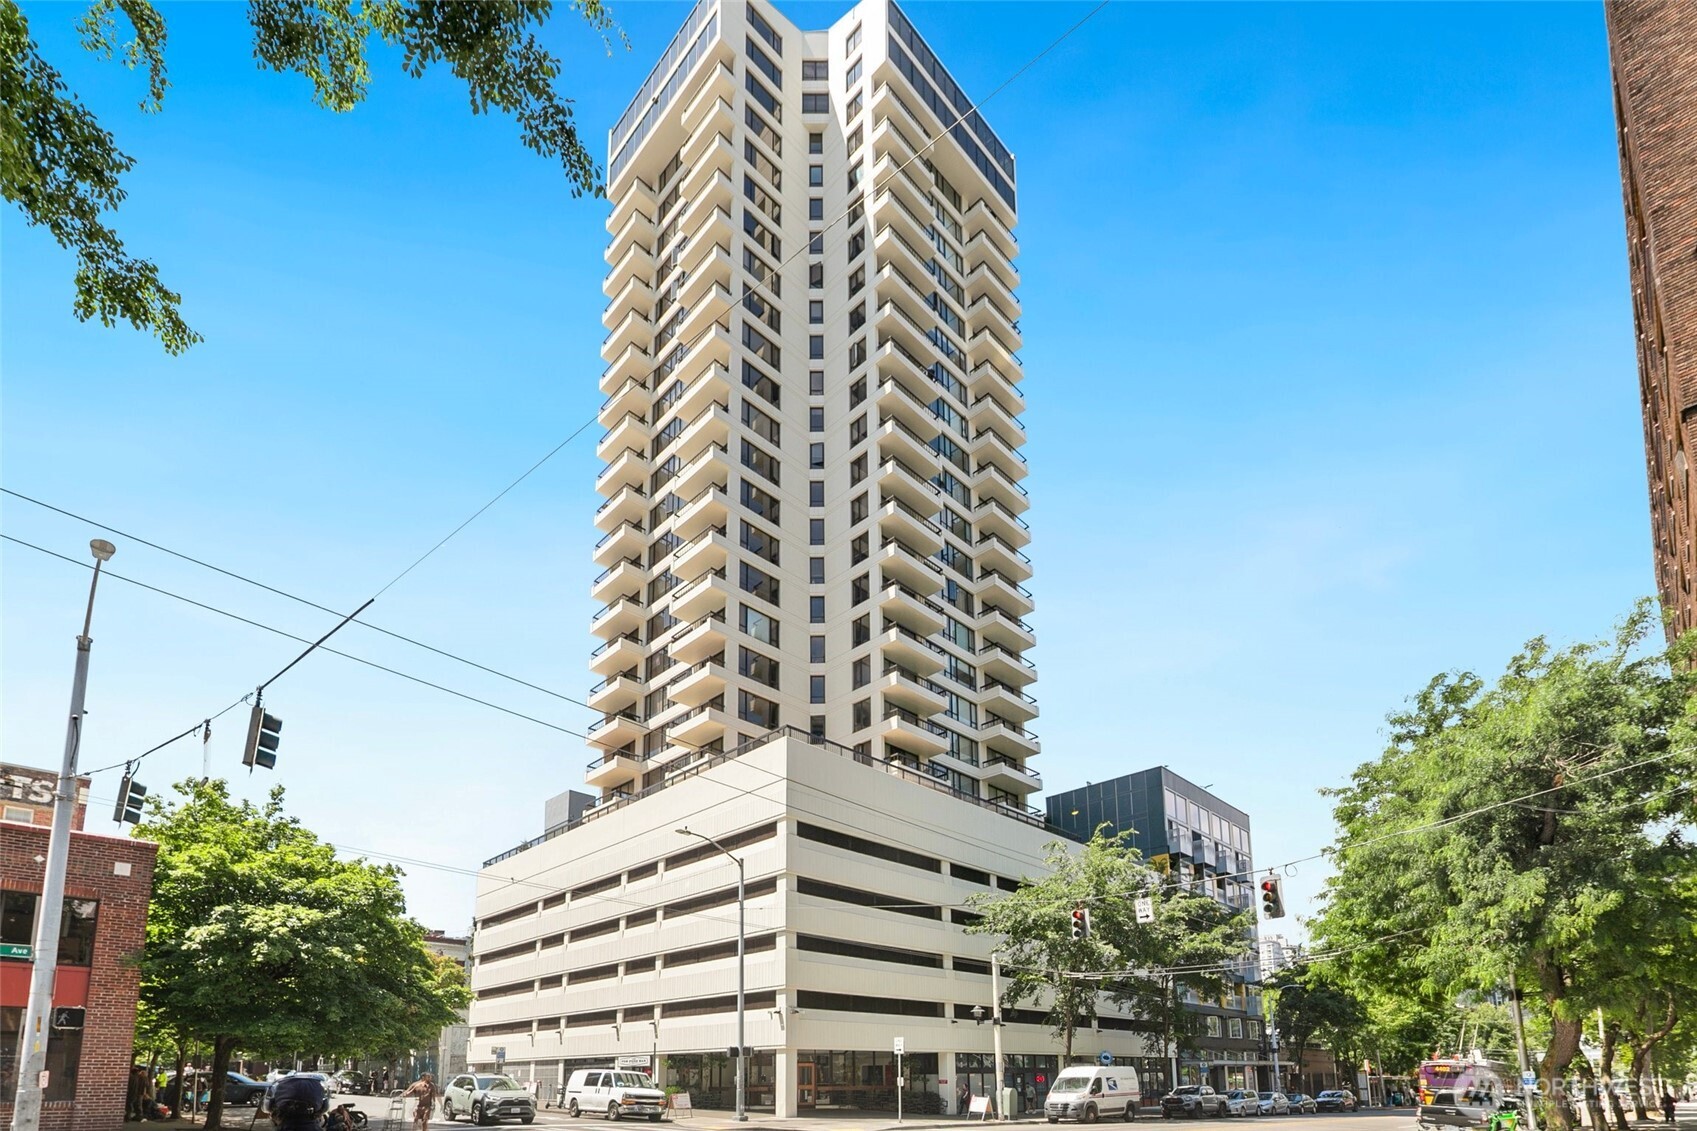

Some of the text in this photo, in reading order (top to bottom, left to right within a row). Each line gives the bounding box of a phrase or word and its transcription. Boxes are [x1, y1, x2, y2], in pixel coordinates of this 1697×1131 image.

[0, 775, 54, 803] TS
[1137, 899, 1150, 907] ONE
[11, 947, 28, 955] Ave
